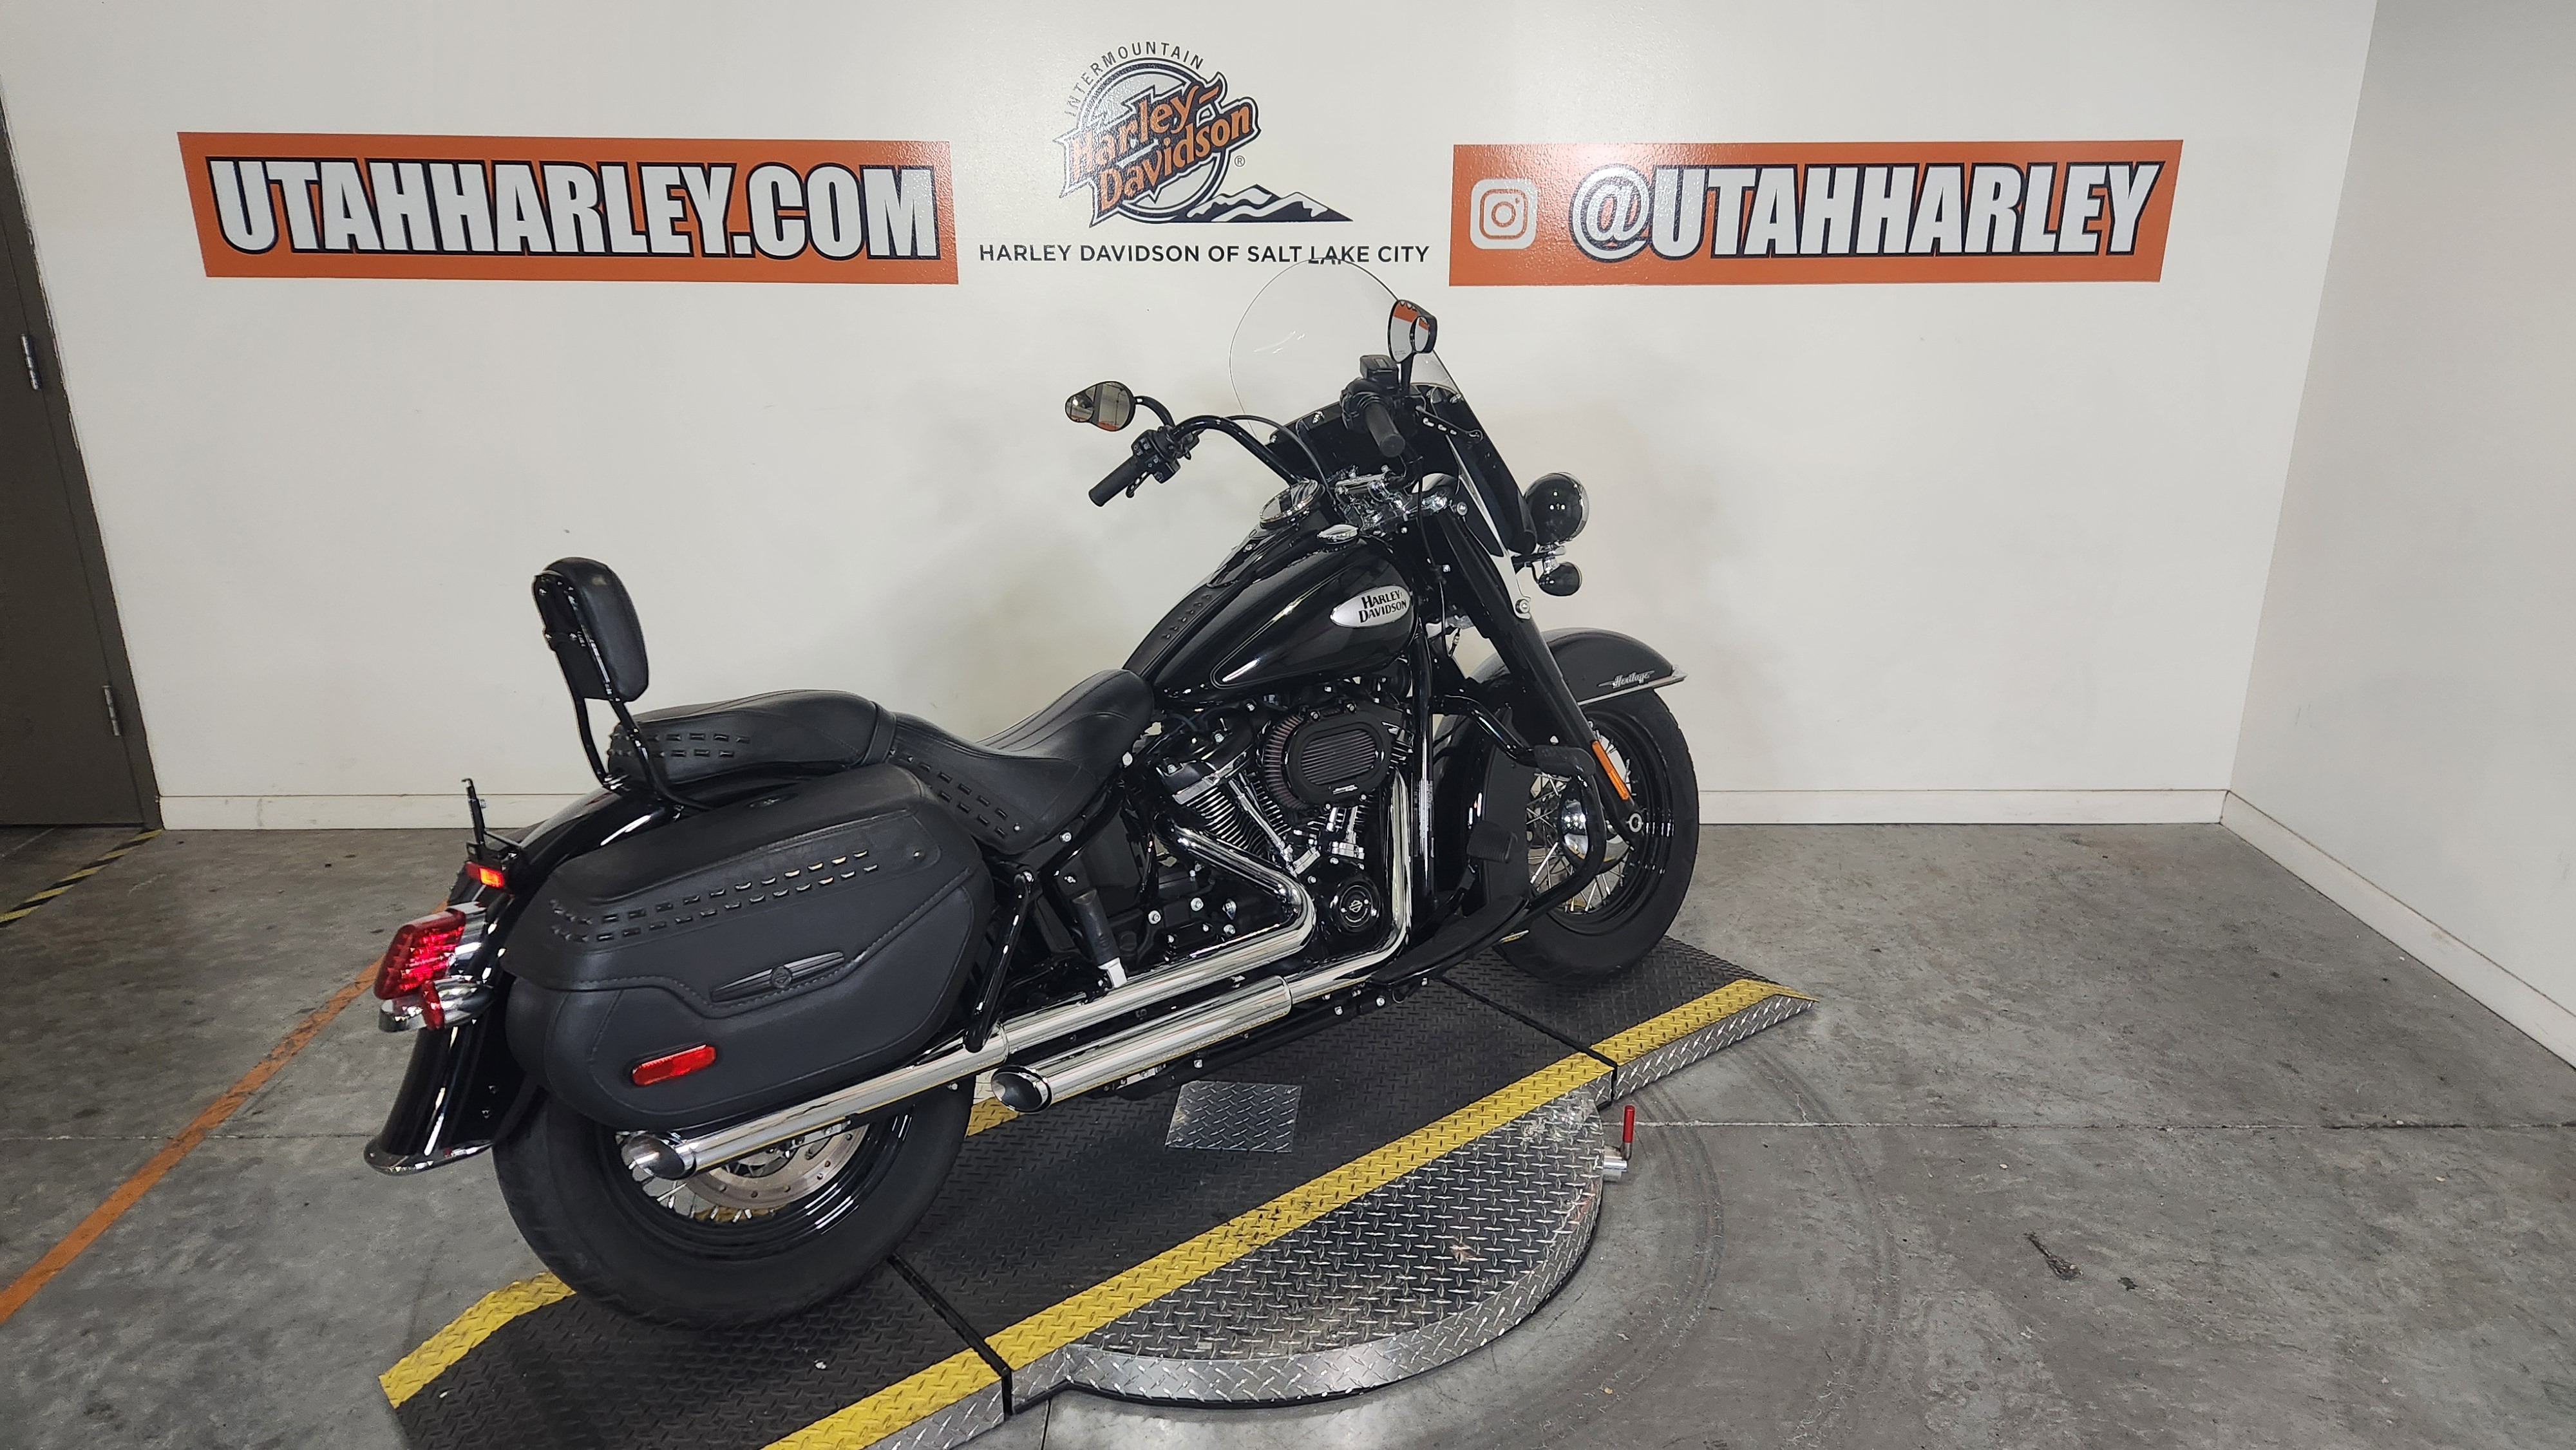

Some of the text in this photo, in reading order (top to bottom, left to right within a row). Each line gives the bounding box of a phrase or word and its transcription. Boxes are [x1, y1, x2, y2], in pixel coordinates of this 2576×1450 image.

[1065, 41, 1204, 117] INTERMOUNTAIN
[1099, 106, 1251, 212] Davidson
[205, 156, 941, 261] UTAHHARLEY.COM
[1569, 161, 2162, 260] @UTAHHARLEY
[979, 244, 1430, 265] HARLEY DAVIDSON OF SALT LAKE CITY
[1358, 599, 1407, 623] DAVIDSON
[1612, 672, 1653, 689] Heritage
